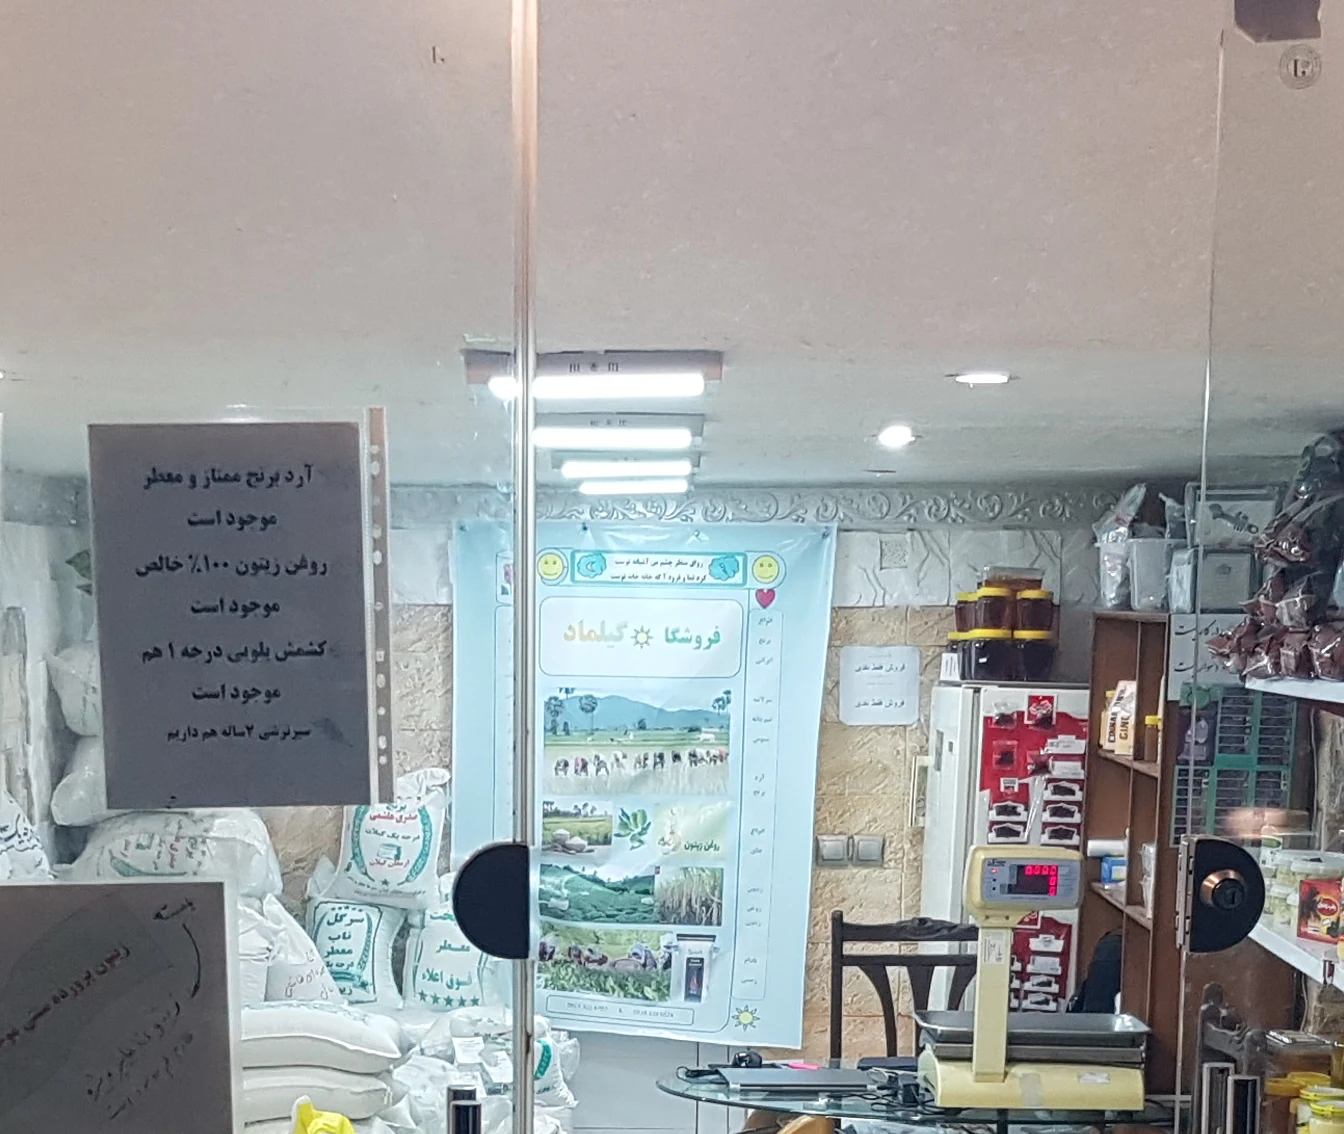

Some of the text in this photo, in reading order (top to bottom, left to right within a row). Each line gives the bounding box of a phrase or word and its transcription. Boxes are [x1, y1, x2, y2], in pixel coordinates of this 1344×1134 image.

[142, 463, 313, 490] آرد برنج ممتاز و معطر
[186, 509, 278, 532] موجود است
[135, 554, 184, 578] خالص
[234, 556, 281, 577] زیتون
[284, 553, 328, 577] روغن
[190, 598, 281, 619] موجود است
[563, 619, 629, 649] گیلماد
[141, 645, 163, 665] هم
[180, 644, 223, 664] درجه
[274, 640, 327, 663] کشمش
[884, 663, 906, 673] فروش
[191, 683, 282, 705] موجود است
[884, 698, 905, 708] فروش
[166, 724, 200, 743] داریم
[201, 728, 218, 743] هم
[327, 931, 352, 943] ناب
[323, 945, 353, 959] معطر
